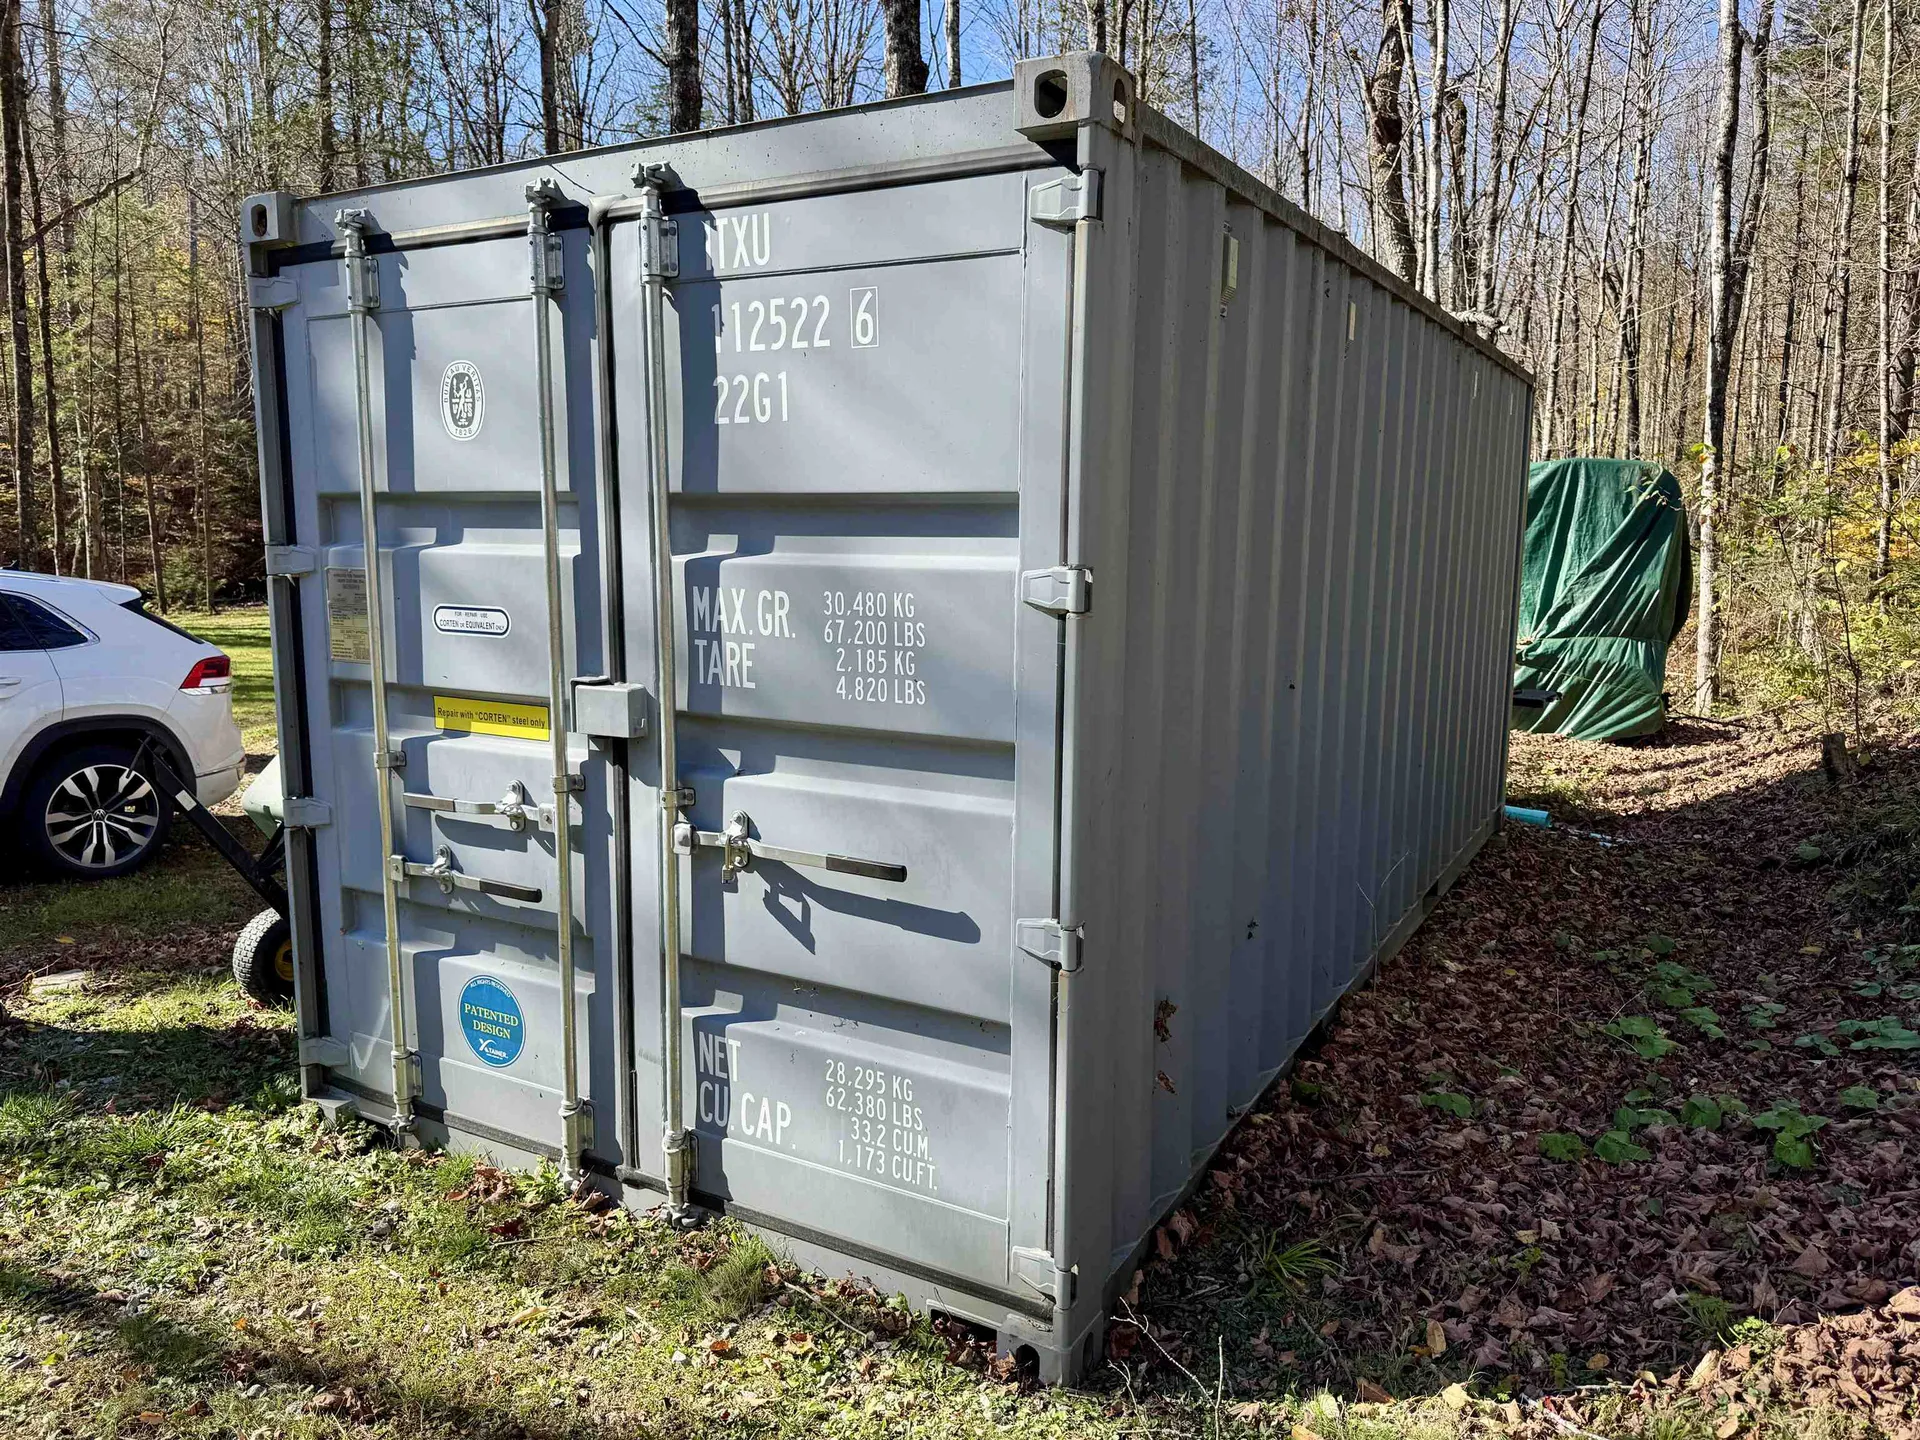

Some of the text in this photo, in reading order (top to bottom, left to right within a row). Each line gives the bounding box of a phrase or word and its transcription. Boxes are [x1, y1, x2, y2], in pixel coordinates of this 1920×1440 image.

[711, 290, 874, 354] 112522 6
[713, 371, 788, 425] 22G1
[823, 591, 887, 617] 30,480
[894, 592, 915, 618] KG
[439, 619, 459, 628] CORTEN
[465, 620, 495, 630] EQUIVALENT
[824, 619, 926, 648] 67,200 LBS
[694, 639, 915, 689] TARE 2,185 KG
[836, 676, 926, 705] 4,820 LBS
[437, 707, 459, 719] Repair
[460, 710, 474, 720] with
[512, 716, 529, 725] steel
[530, 718, 546, 729] only
[463, 1002, 519, 1027] PATENTED
[472, 1019, 511, 1040] DESIGN
[699, 1031, 913, 1102] NET 28,295 KG
[826, 1086, 923, 1131] 62,380 LBS
[850, 1117, 886, 1148] 33.2
[838, 1139, 885, 1174] 1,173
